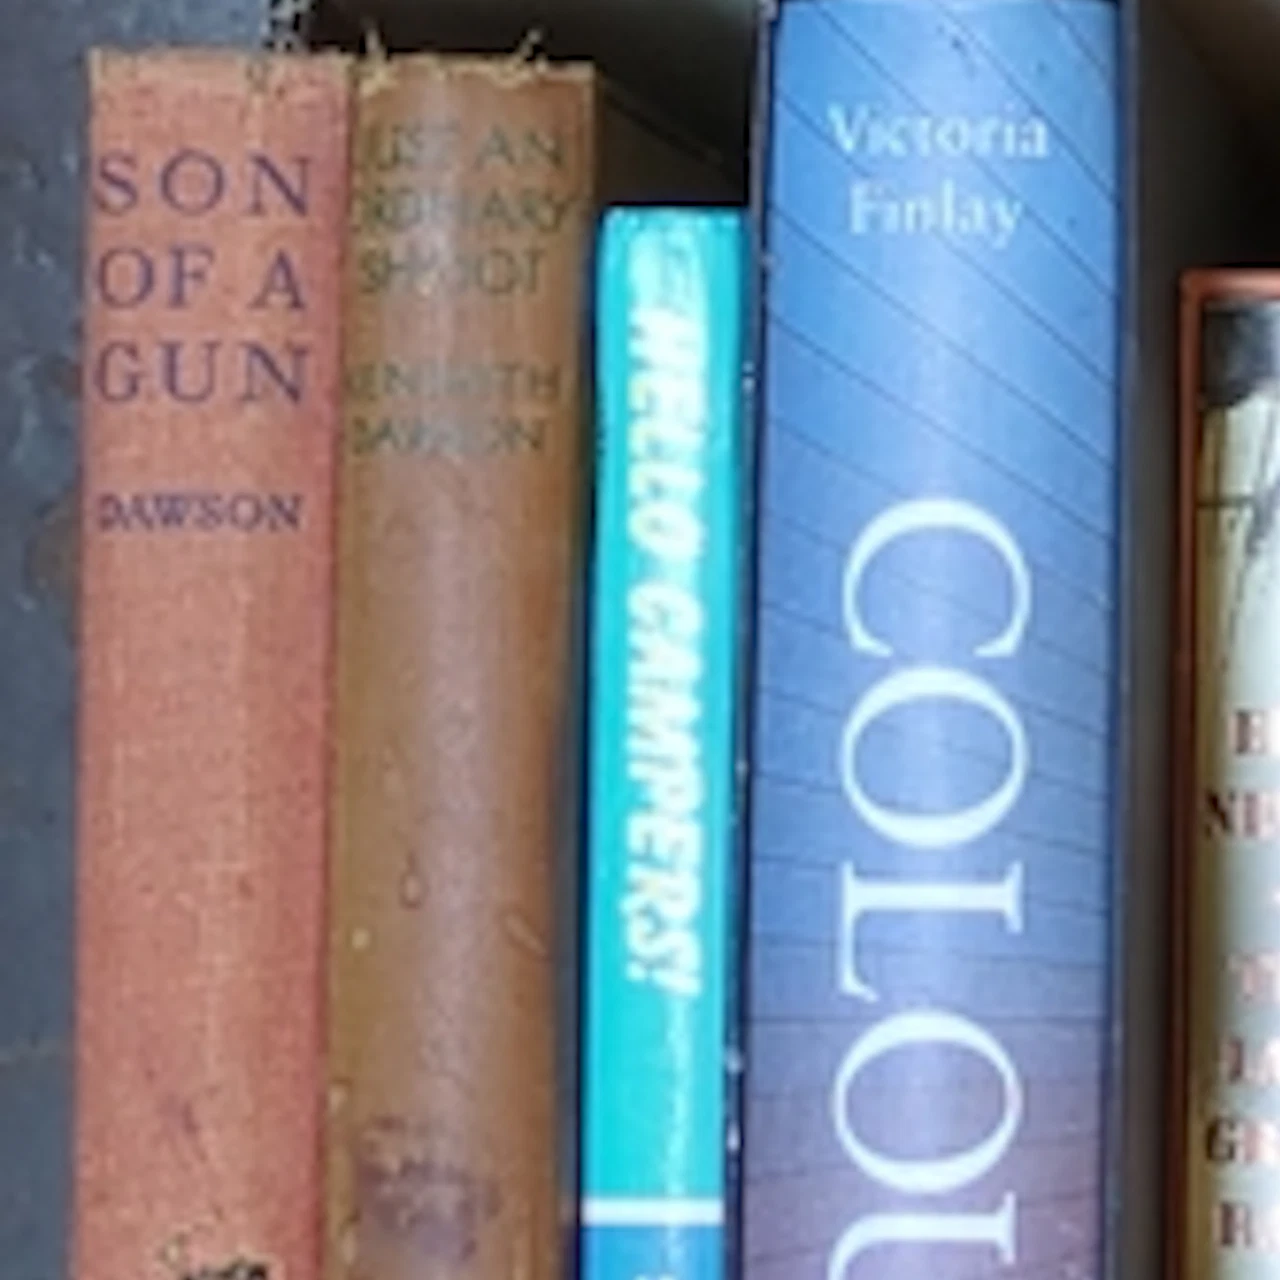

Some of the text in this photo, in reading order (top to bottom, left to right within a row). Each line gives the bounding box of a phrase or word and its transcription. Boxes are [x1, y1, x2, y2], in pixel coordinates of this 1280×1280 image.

[828, 103, 1049, 158] Victoria
[91, 149, 309, 218] SON
[850, 179, 1022, 249] Finlay
[93, 246, 307, 311] OF A
[91, 340, 309, 405] GUN
[98, 492, 305, 533] DAWSON
